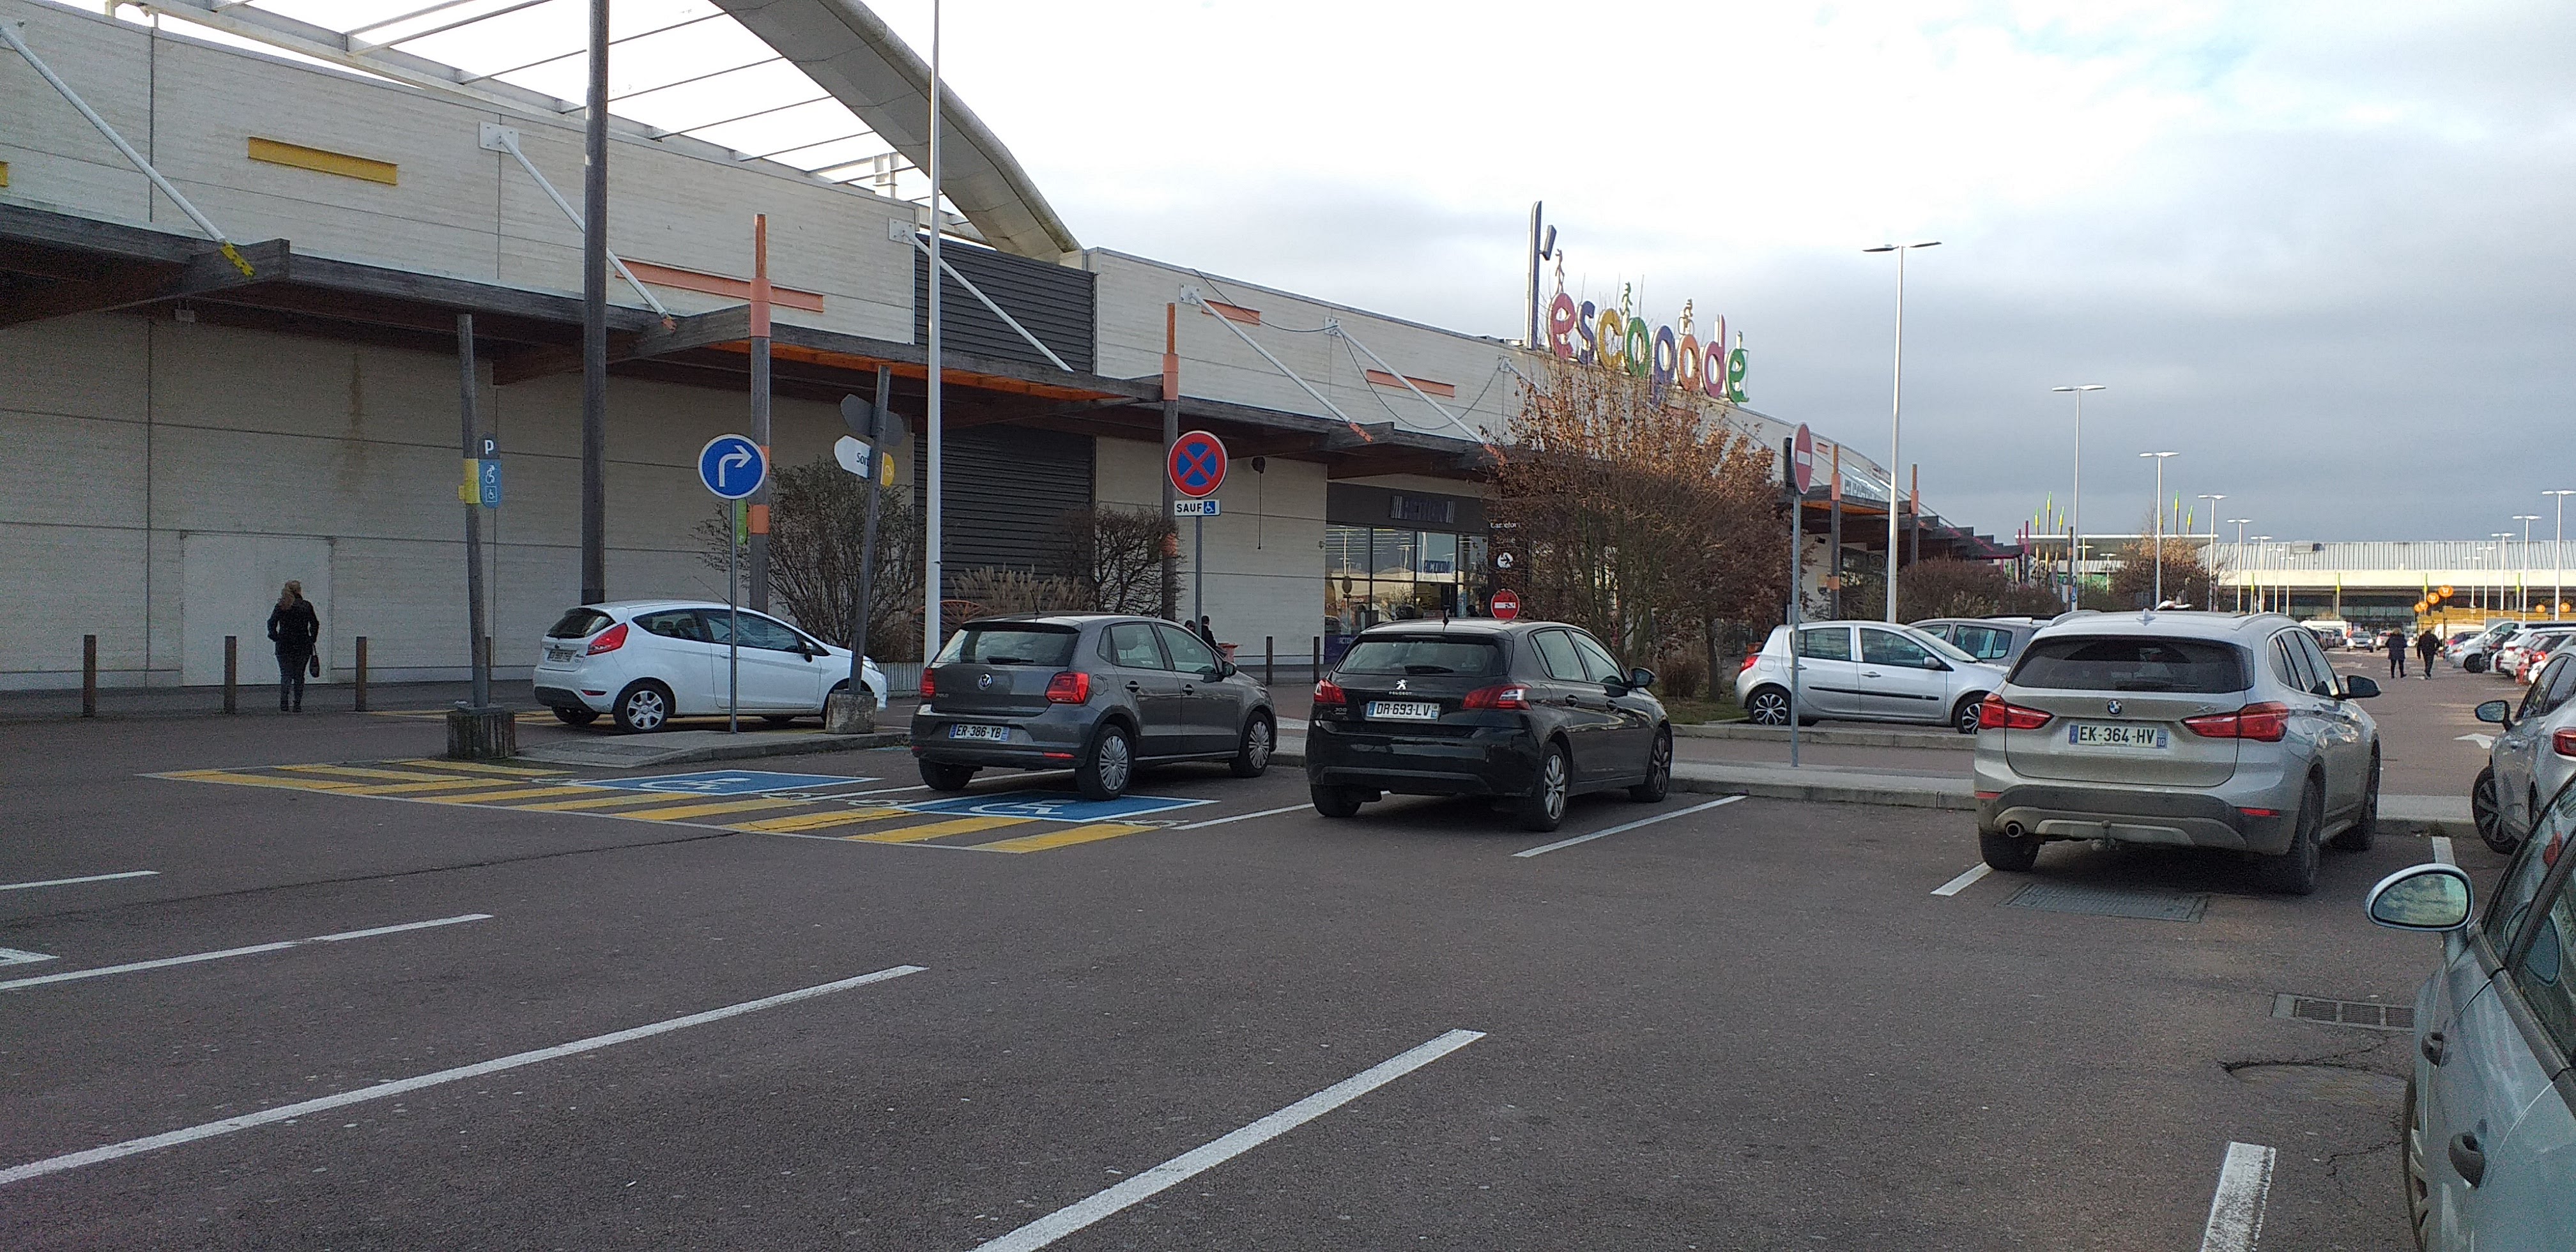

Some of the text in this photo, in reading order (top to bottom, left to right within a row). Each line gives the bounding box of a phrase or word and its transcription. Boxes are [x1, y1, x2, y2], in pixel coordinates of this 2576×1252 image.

[856, 452, 870, 467] Sort
[1176, 503, 1202, 513] SAUF
[1376, 703, 1430, 716] DR-693-LV
[956, 725, 1001, 738] ER-386-YB
[2079, 726, 2155, 744] EK-364-HV
[2158, 738, 2165, 746] 10
